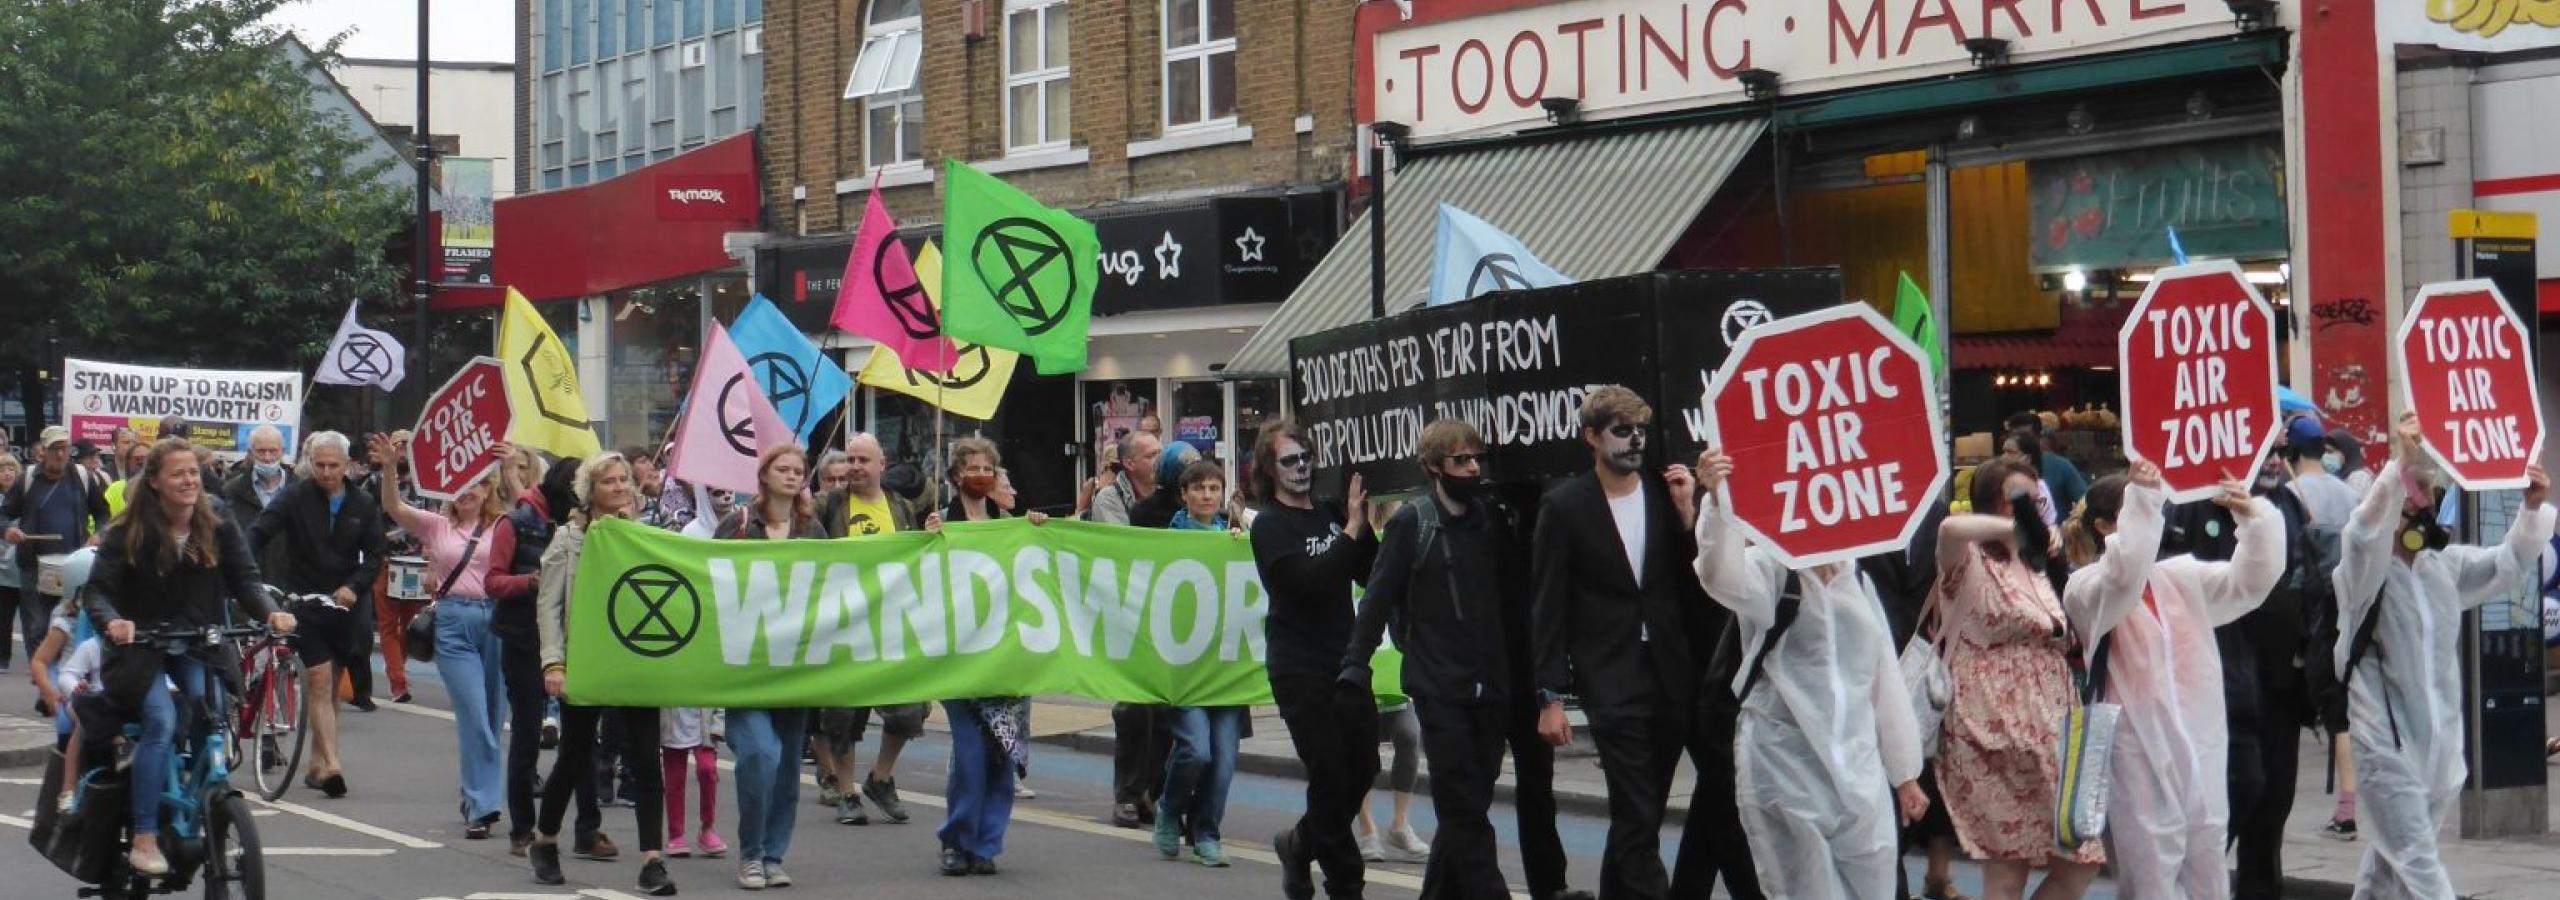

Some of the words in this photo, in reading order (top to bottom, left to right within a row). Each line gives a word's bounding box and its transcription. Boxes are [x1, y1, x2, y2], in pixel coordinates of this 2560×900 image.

[1400, 0, 1750, 121] TOOTING
[2106, 158, 2256, 229] Fruits
[444, 248, 491, 258] FRAMED
[1297, 354, 1330, 406] 300
[1330, 344, 1389, 398] DEATHS
[1389, 335, 1424, 388] PER
[1427, 321, 1476, 380] YEAR
[1481, 313, 1561, 374] FROM
[2148, 300, 2252, 358] TOXIC
[2419, 314, 2512, 363] TOXIC
[74, 371, 144, 392] STAND
[149, 376, 179, 395] UP
[183, 378, 211, 397] TO
[216, 380, 293, 401] RACISM
[108, 394, 260, 420] WANDSWORTH
[421, 373, 486, 443] TOXIC
[1742, 346, 1900, 421] TOXIC
[2173, 355, 2229, 411] AIR
[2446, 367, 2498, 413] AIR
[435, 422, 494, 488] ZONE
[441, 410, 476, 457] AIR
[1335, 404, 1424, 467] POLLUTION
[1786, 411, 1868, 473] AIR
[2161, 408, 2254, 469] ZONE
[2444, 415, 2526, 463] ZONE
[1772, 462, 1908, 533] ZONE
[707, 544, 1268, 668] WANDSWOR
